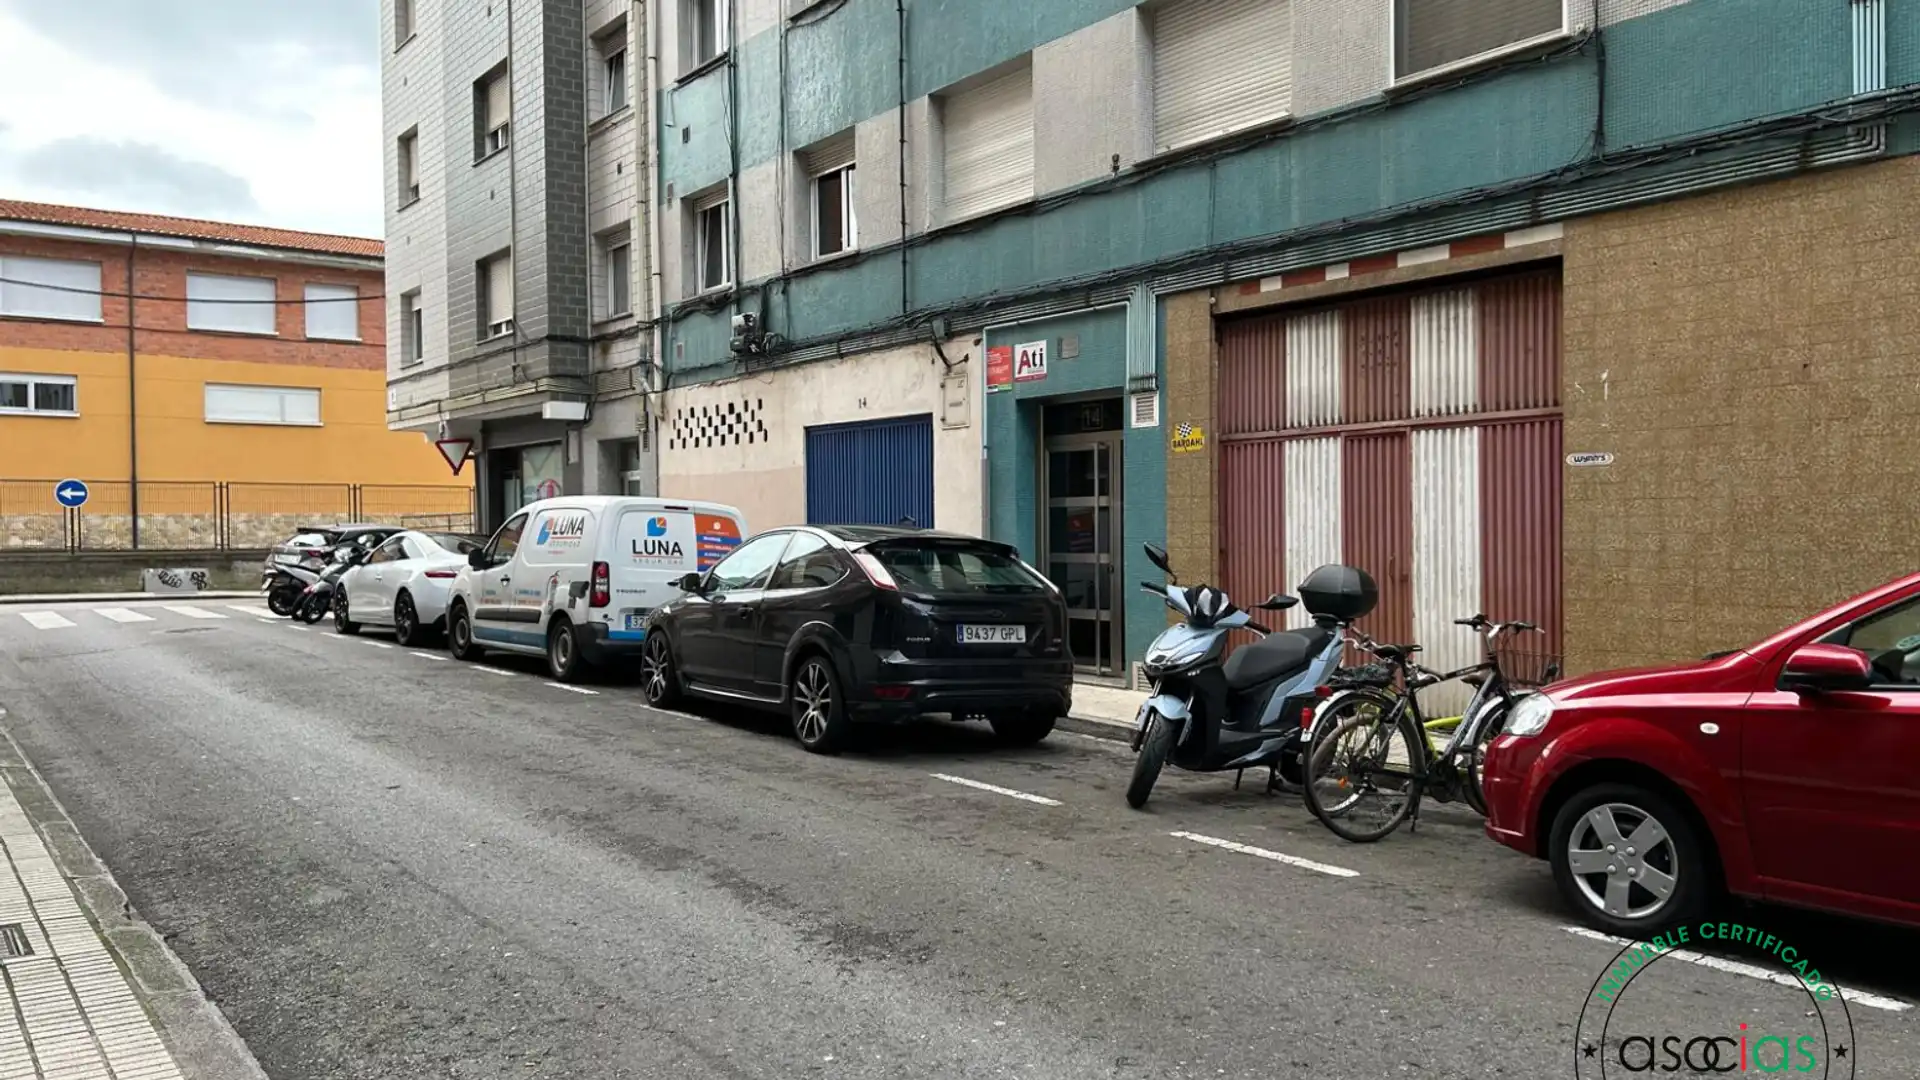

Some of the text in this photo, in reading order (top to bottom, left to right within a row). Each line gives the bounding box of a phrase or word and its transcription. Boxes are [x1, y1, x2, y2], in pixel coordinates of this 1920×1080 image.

[1017, 347, 1044, 375] Ati
[858, 396, 867, 409] 14
[1083, 406, 1101, 427] 14
[1172, 437, 1203, 448] BARDAHL
[551, 515, 585, 536] LUNA
[632, 539, 684, 557] LUNA
[965, 626, 1024, 641] 9437 GPL
